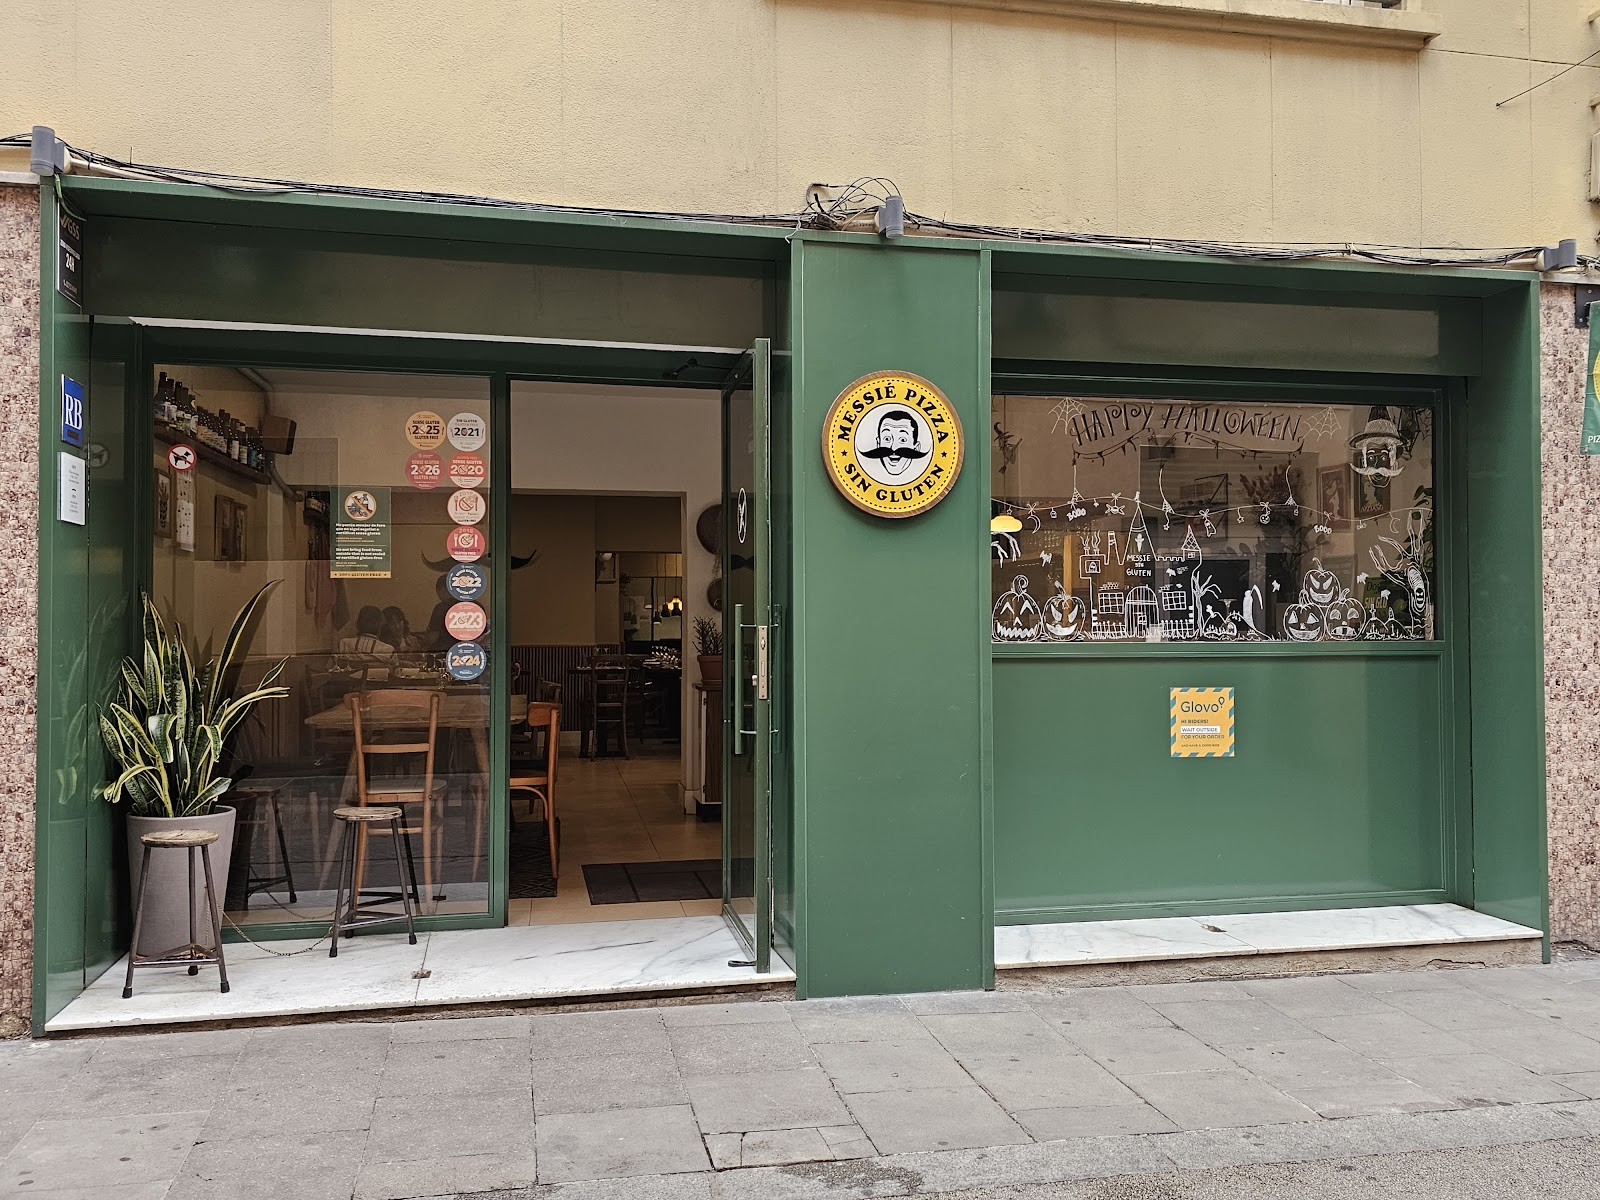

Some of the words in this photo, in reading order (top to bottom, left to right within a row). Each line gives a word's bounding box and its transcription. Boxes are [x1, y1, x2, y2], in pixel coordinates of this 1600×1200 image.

[64, 393, 83, 430] RB
[837, 382, 897, 442] MESSIÉ
[904, 387, 949, 443] PIZZA
[1070, 404, 1154, 447] HAPPY
[1161, 405, 1303, 442] HALLOWEEN
[454, 428, 479, 437] 2021
[844, 463, 873, 493] SIN
[876, 464, 945, 503] GLUTEN
[1126, 567, 1152, 576] GLUTEN
[1181, 701, 1219, 712] Glovo
